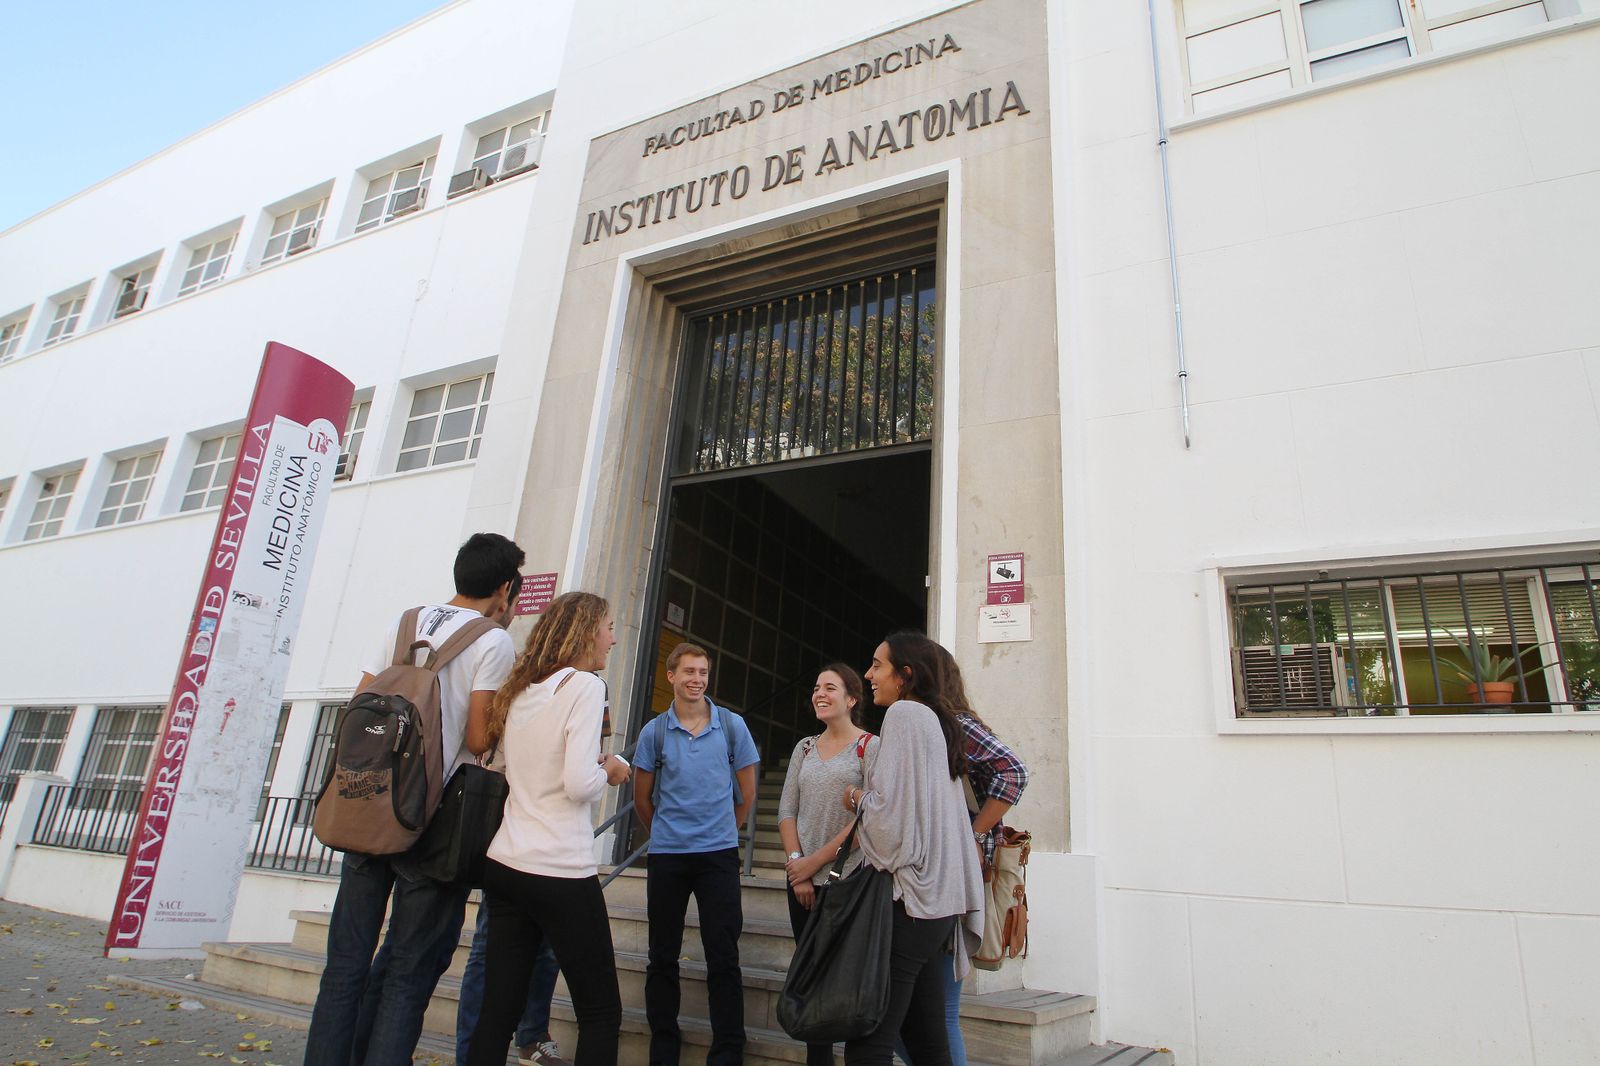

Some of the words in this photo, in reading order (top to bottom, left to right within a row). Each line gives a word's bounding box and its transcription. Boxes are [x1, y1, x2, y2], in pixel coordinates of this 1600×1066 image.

[642, 99, 765, 158] FACULTAD
[772, 84, 804, 114] DE
[810, 33, 962, 100] MEDICINA
[582, 165, 750, 246] INSTITUTO
[761, 145, 805, 192] DE
[814, 80, 1030, 177] ANATOMIA
[215, 422, 272, 571] SEVILLA
[262, 459, 282, 507] FACULTAD
[276, 444, 286, 458] DE
[262, 454, 308, 571] MEDICINA
[277, 544, 302, 618] INSTITUTO
[299, 461, 322, 543] ANATÓMICO
[347, 776, 372, 792] NAME
[159, 900, 184, 910] SACU
